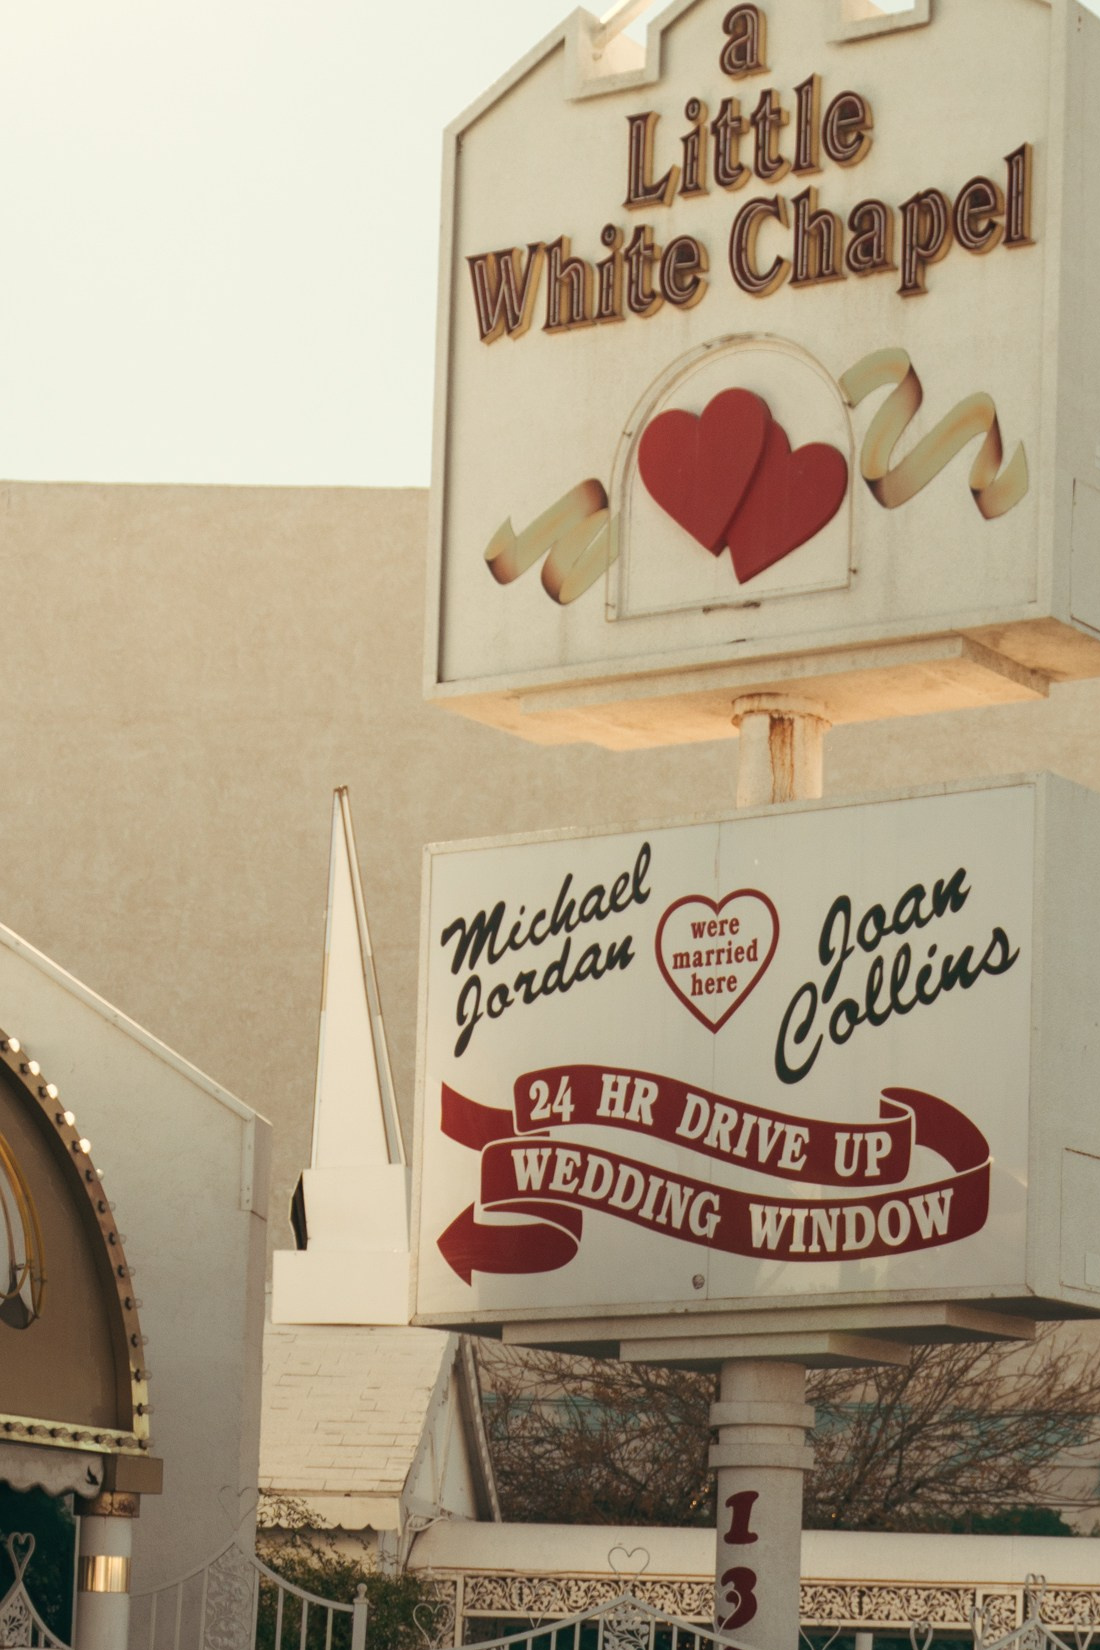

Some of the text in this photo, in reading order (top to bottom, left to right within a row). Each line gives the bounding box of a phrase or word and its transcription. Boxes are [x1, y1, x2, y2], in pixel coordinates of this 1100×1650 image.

[720, 3, 769, 79] a
[622, 72, 875, 212] Little
[466, 141, 1038, 345] White Chapel
[440, 841, 652, 975] Michael
[672, 937, 759, 970] married
[690, 917, 740, 939] were
[818, 867, 972, 1004] Joan
[454, 935, 636, 1058] Jordan
[690, 972, 738, 997] here
[774, 926, 1021, 1085] Collins
[528, 1072, 893, 1178] 24 HR DRIVE UP
[511, 1147, 956, 1255] WEDDING WINDOW
